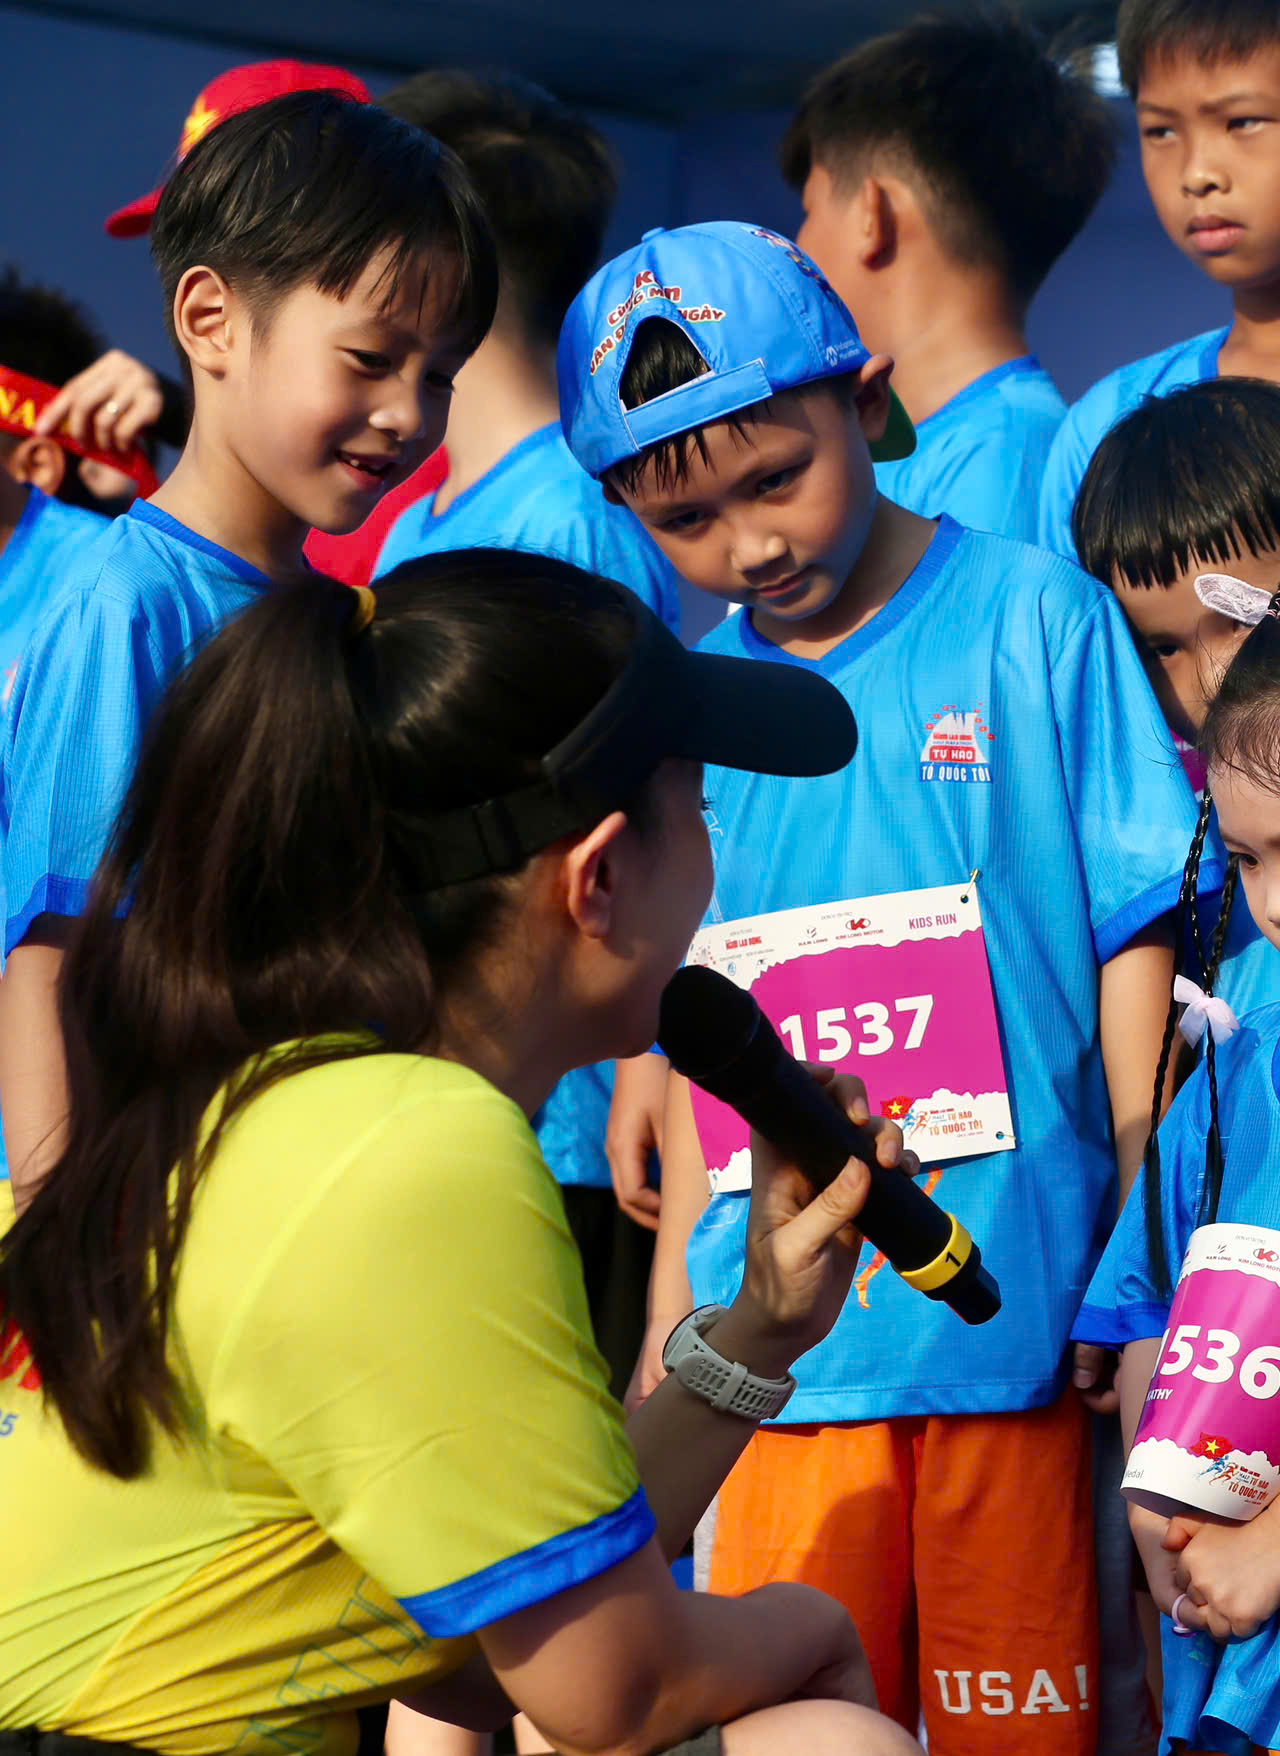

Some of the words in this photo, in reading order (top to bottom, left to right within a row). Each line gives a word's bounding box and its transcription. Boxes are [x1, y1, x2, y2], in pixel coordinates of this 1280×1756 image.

[908, 916, 933, 930] KIDS
[935, 912, 957, 927] RUN
[779, 993, 935, 1063] 1537
[945, 1251, 961, 1268] 1
[1250, 1260, 1265, 1268] LONG
[934, 1664, 1089, 1716] USA!
